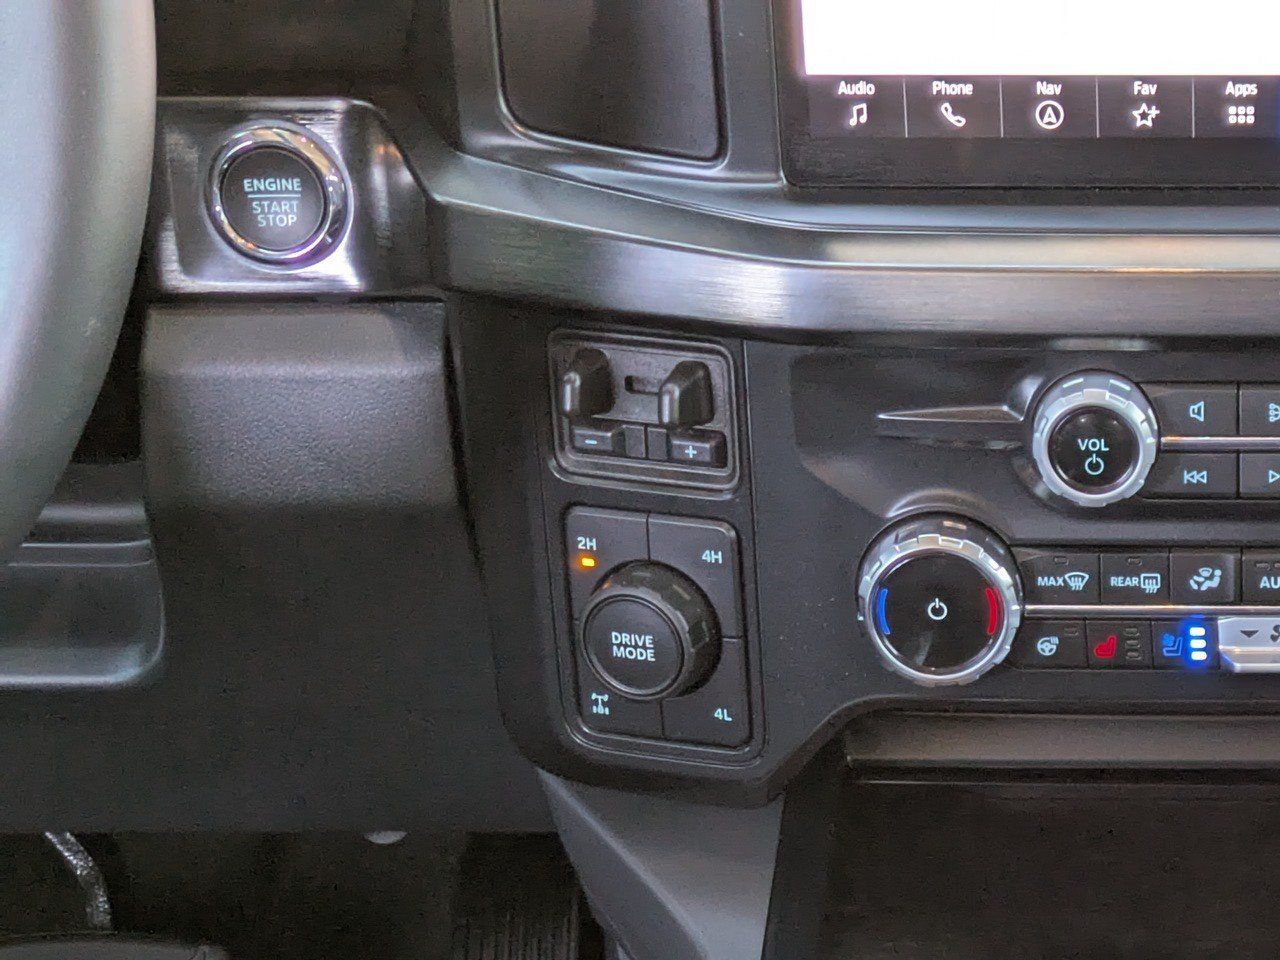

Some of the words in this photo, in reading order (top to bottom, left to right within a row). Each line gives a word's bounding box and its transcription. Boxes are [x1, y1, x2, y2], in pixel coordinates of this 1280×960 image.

[838, 80, 876, 95] Audio
[932, 80, 973, 95] Phone
[1036, 81, 1062, 95] Nav
[1133, 80, 1157, 95] Fav
[1225, 80, 1258, 97] Apps
[243, 178, 302, 192] ENGINE
[252, 201, 299, 214] START
[257, 214, 297, 227] STOP
[1077, 438, 1110, 452] VOL
[577, 536, 597, 551] 2H
[701, 549, 723, 564] 4H
[1037, 576, 1064, 587] MAX
[1110, 576, 1139, 587] REAR
[611, 631, 654, 648] DRIVE
[612, 645, 656, 662] MODE
[713, 708, 732, 722] 4L
